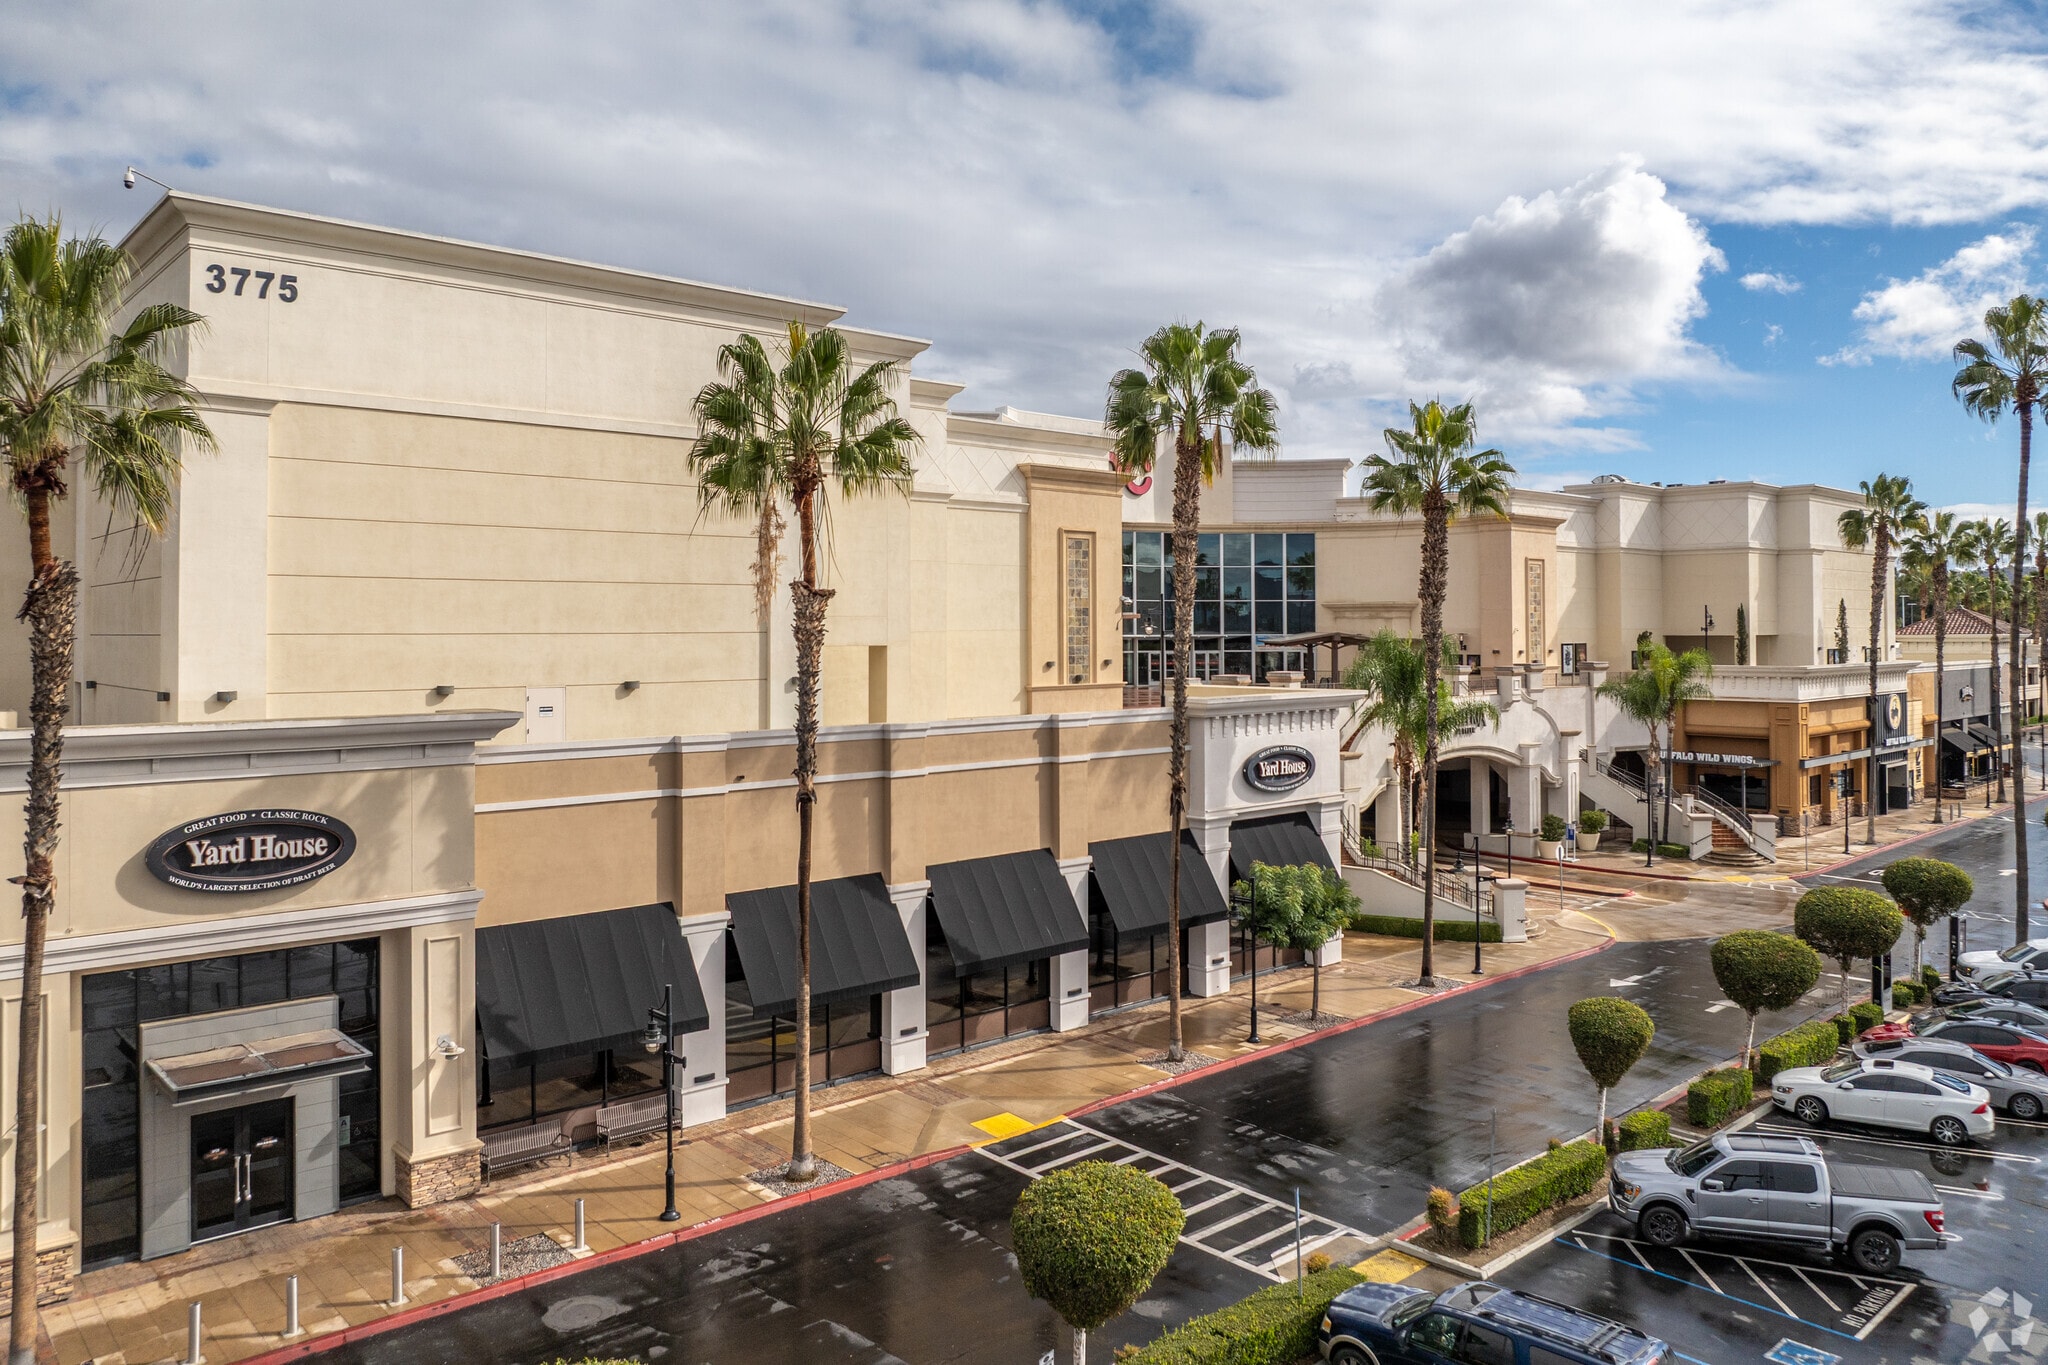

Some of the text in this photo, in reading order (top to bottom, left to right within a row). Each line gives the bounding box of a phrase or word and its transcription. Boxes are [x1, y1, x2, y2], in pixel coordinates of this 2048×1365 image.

[205, 263, 299, 304] 3775
[1260, 760, 1306, 777] Yard House
[1696, 752, 1720, 763] WILD
[184, 811, 329, 835] GREAT FOOD CLASSIC ROCK
[186, 834, 329, 867] Yard House
[168, 862, 336, 891] WORLD'S LARGEST SELECTION OF DRAFT BEER
[1840, 1286, 1896, 1328] NO PARKING
